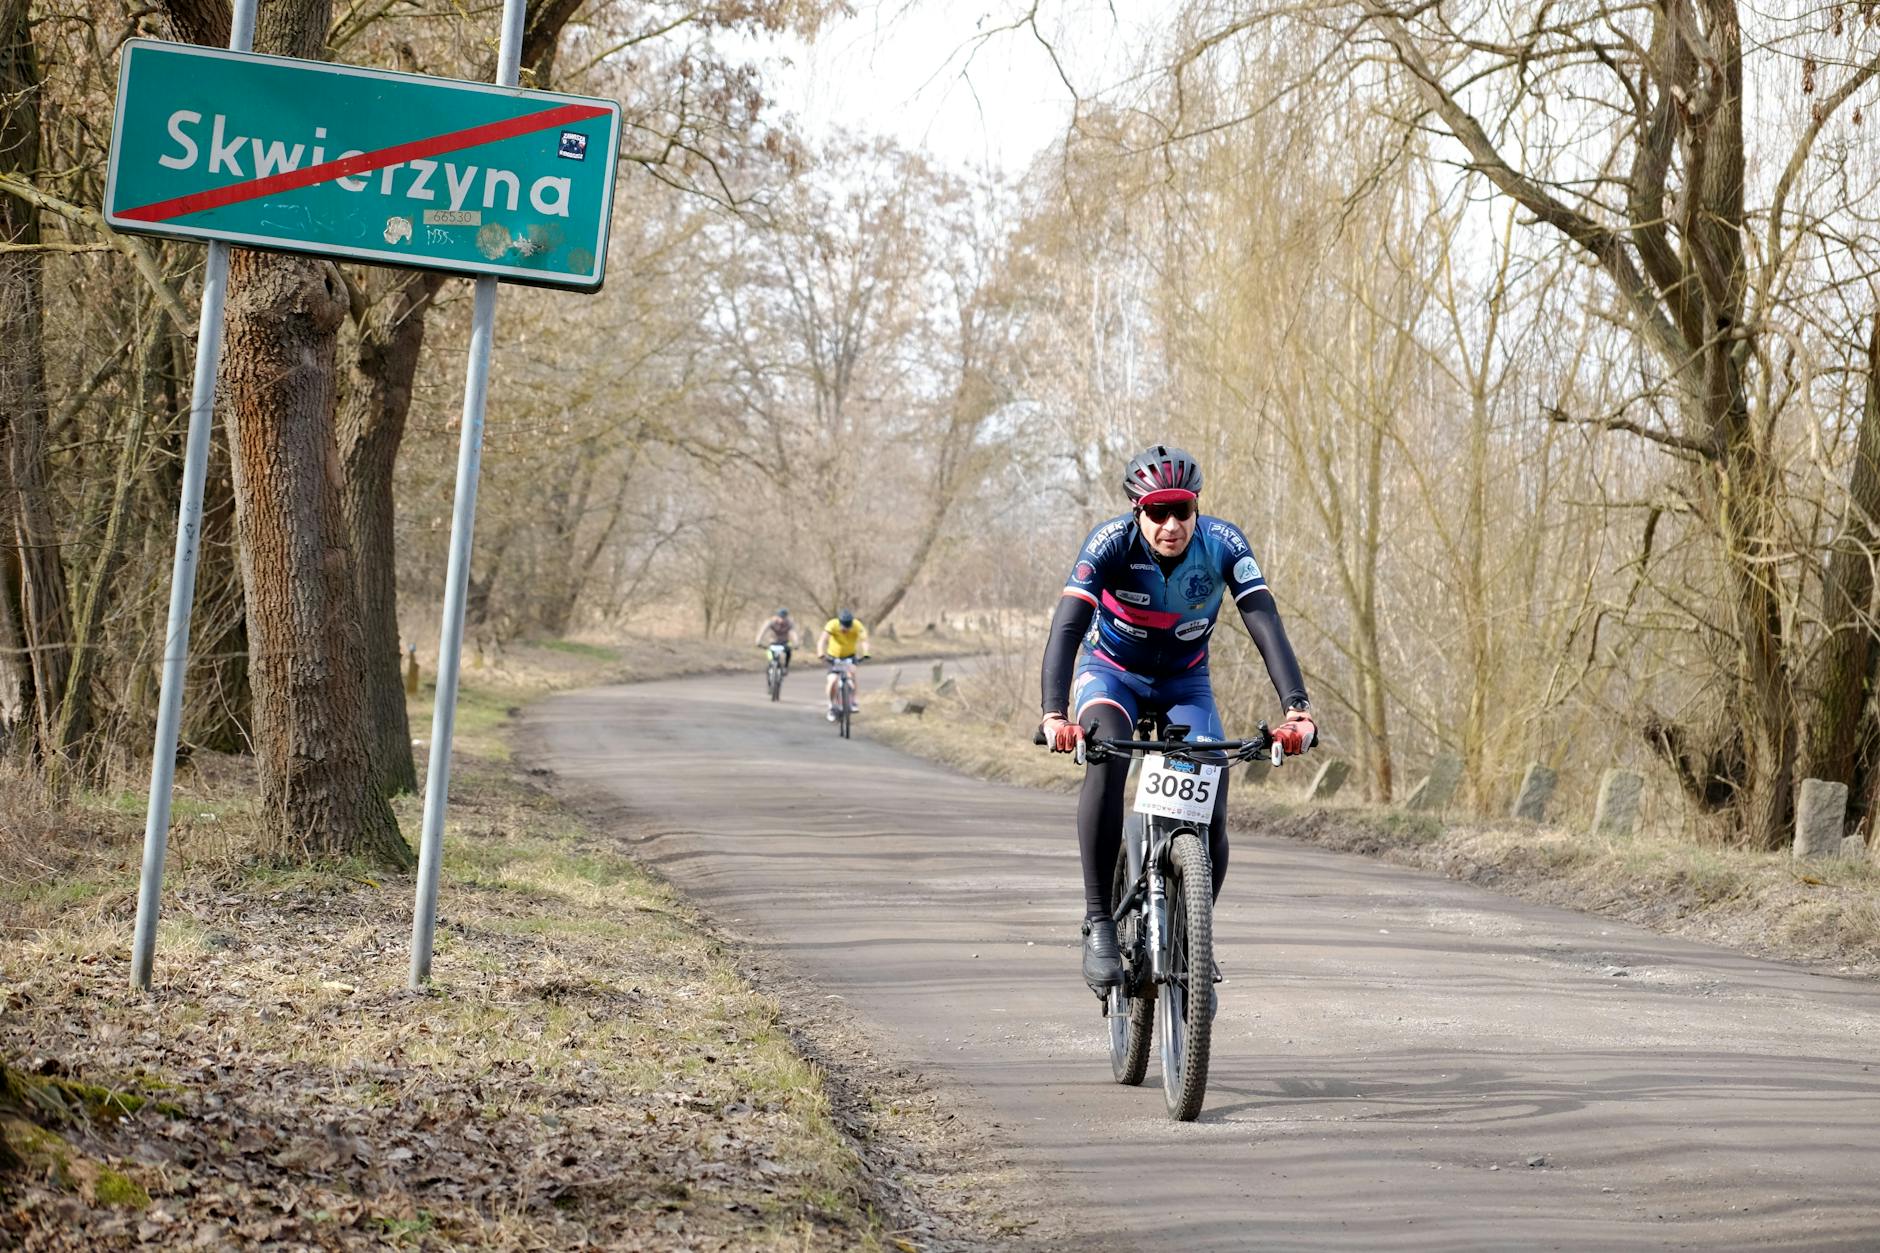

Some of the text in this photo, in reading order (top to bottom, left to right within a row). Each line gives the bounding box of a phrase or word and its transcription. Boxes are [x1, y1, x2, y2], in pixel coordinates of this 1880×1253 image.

[158, 109, 571, 218] Skwierzyna
[433, 210, 472, 223] 66530
[1145, 772, 1211, 804] 3085
